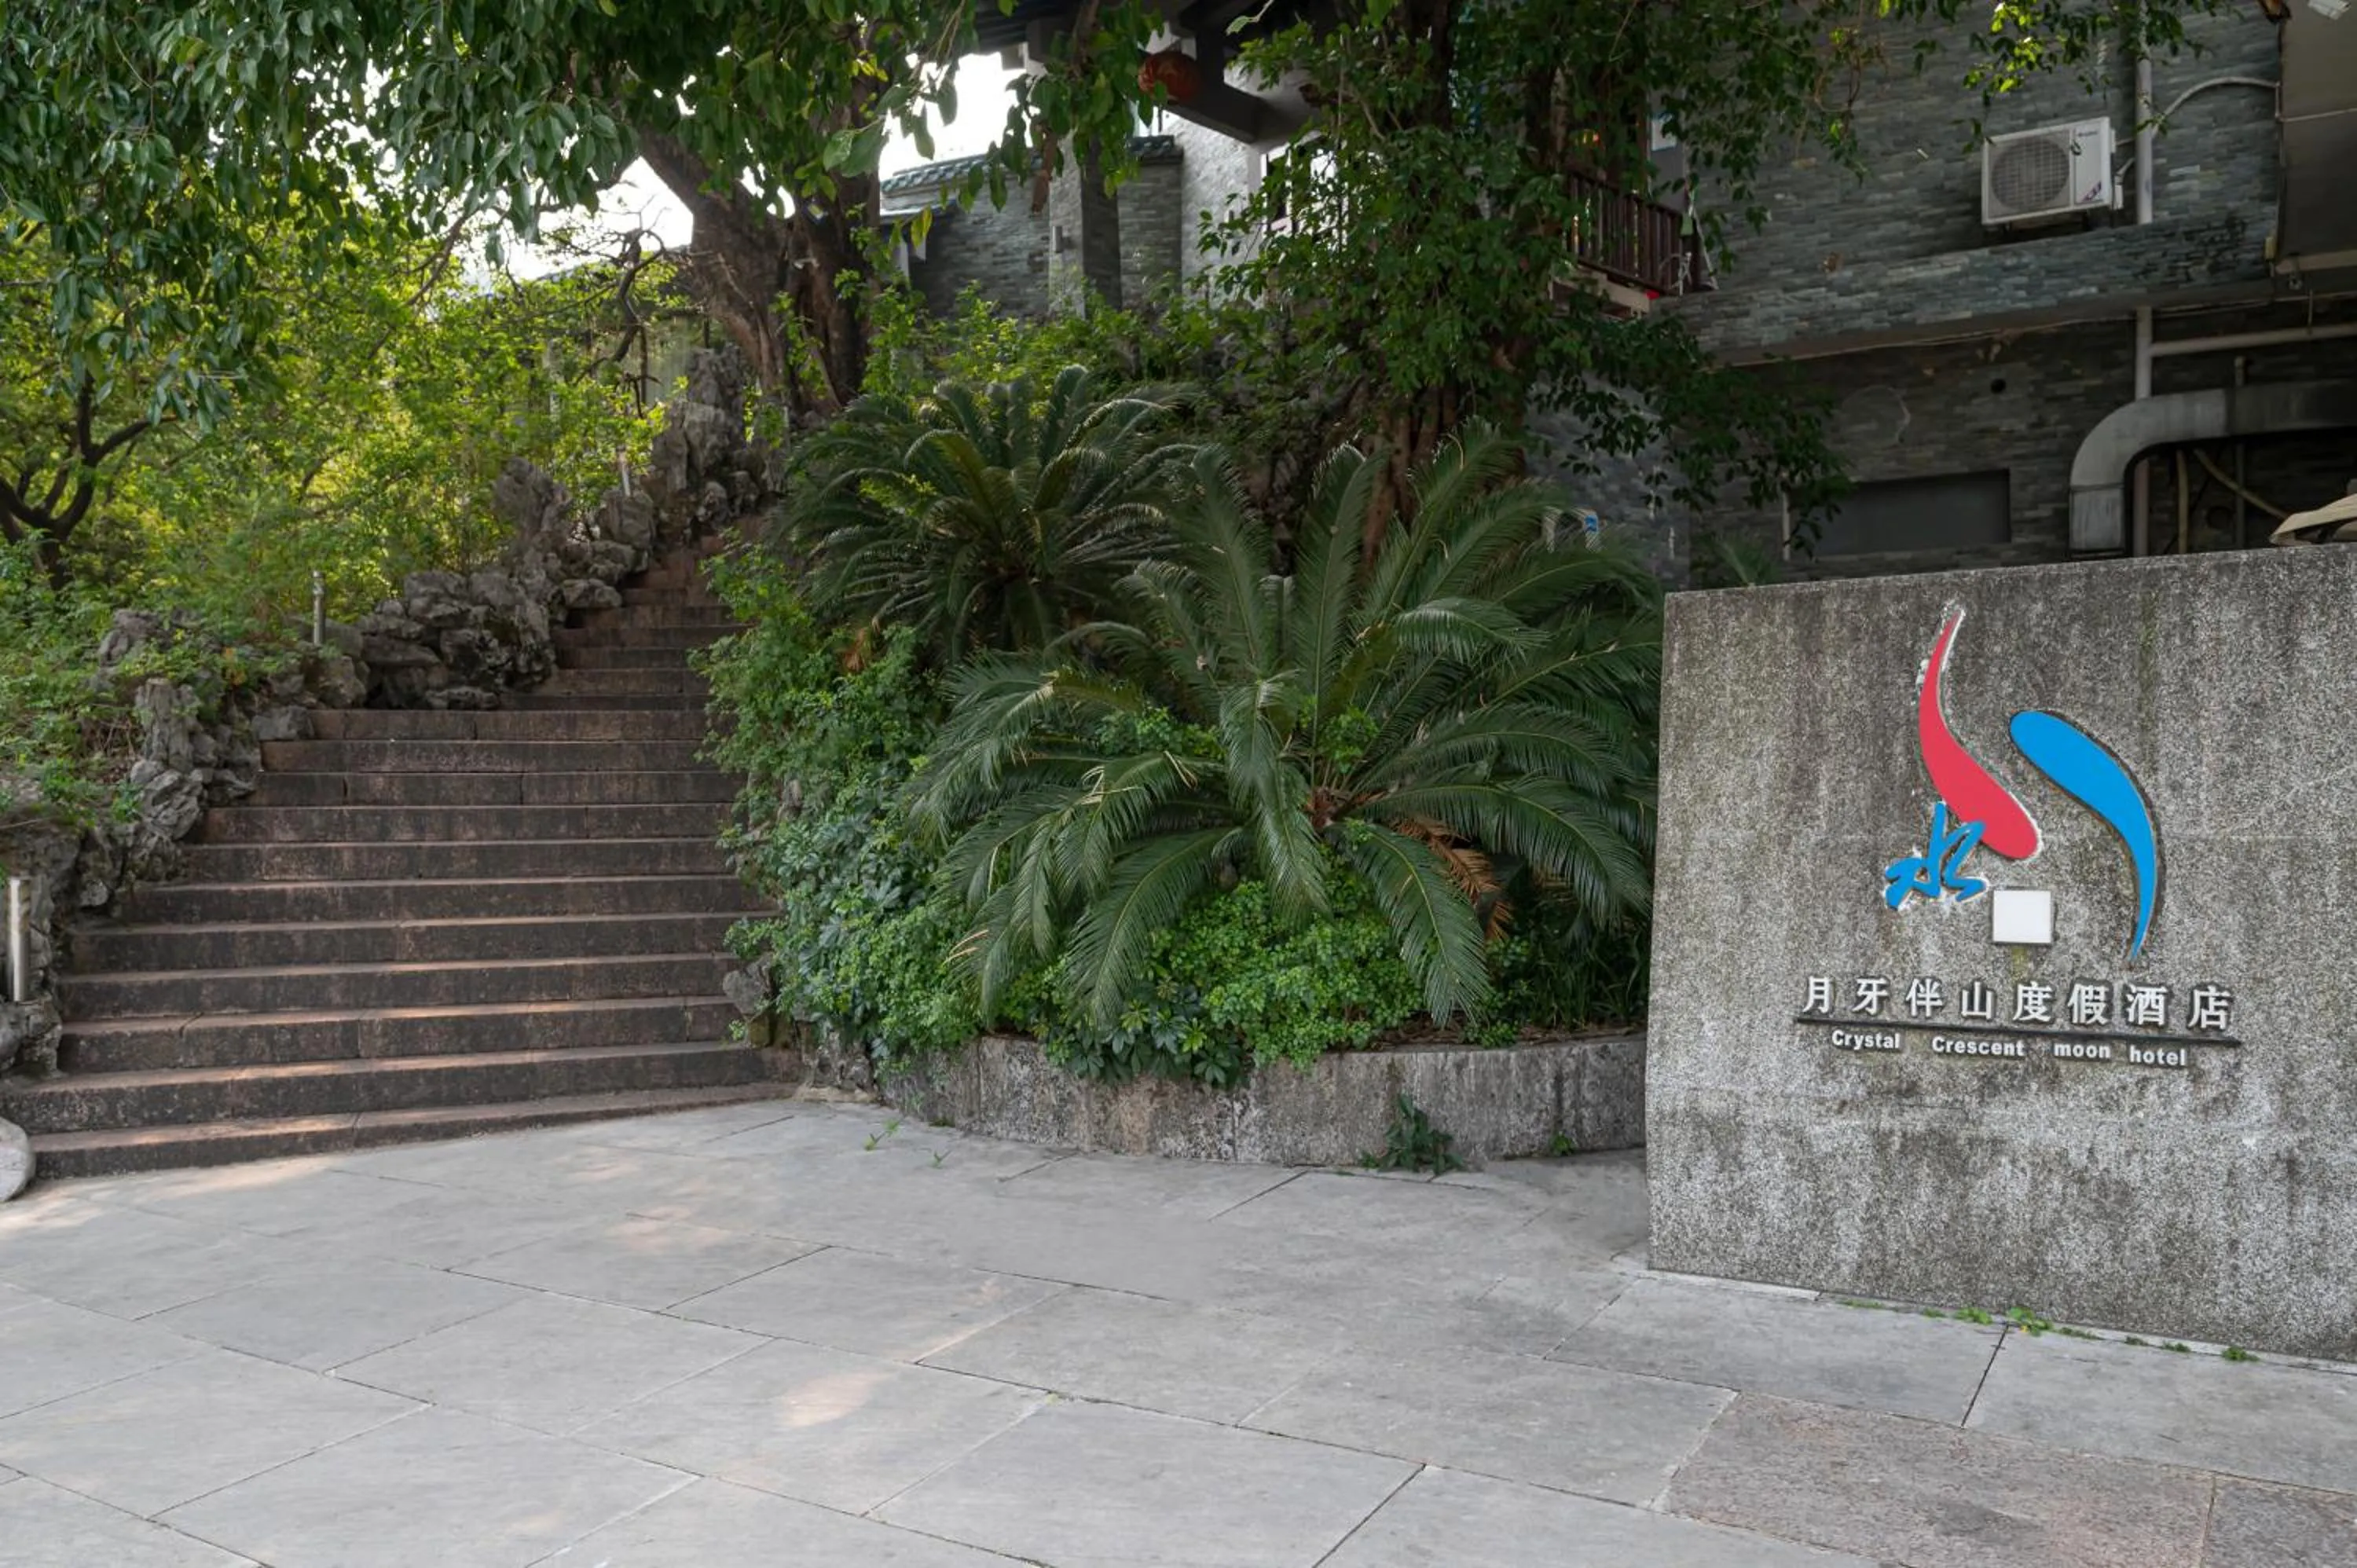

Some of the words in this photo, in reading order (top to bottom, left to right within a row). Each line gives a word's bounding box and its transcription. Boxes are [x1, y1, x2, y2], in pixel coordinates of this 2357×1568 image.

[1802, 976, 2233, 1029] 月牙伴山度假酒店
[1831, 1029, 1901, 1051] Crystal
[1932, 1036, 2025, 1057] Crescent
[2054, 1042, 2111, 1059] moon
[2129, 1046, 2187, 1067] hotel
